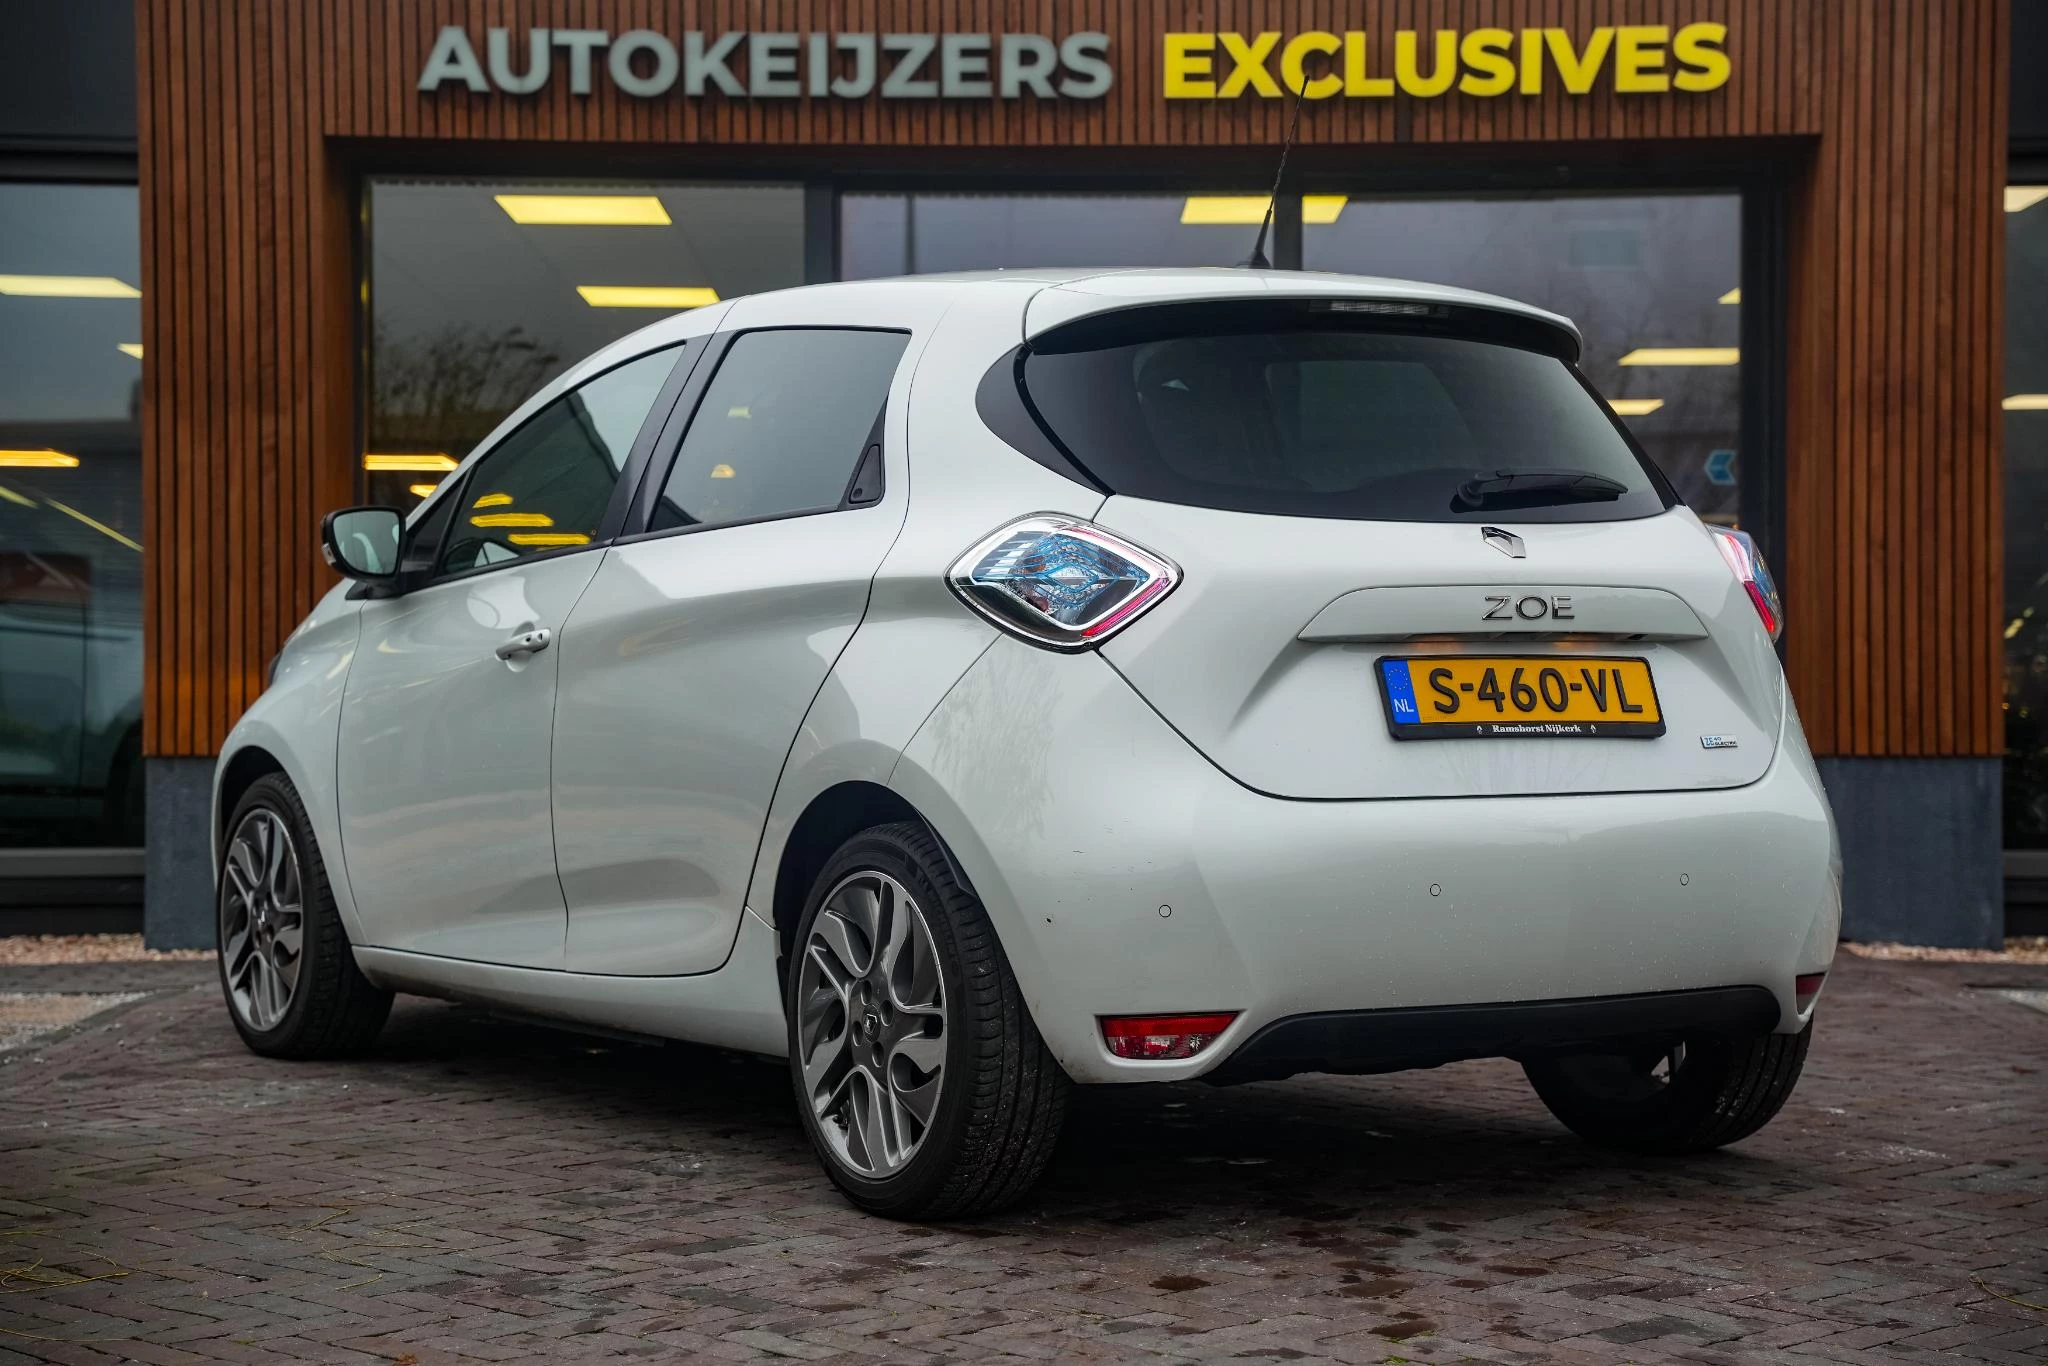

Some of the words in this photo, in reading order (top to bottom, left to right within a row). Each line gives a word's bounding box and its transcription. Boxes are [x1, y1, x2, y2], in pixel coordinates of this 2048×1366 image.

[417, 25, 1113, 98] AUTOKEIJZERS
[1163, 22, 1731, 99] EXCLUSIVES
[1482, 595, 1575, 620] ZOE
[1429, 667, 1643, 714] S-460-VL
[1393, 698, 1415, 713] NL
[1491, 724, 1544, 733] Ramshorst
[1545, 724, 1582, 734] Nijkerk
